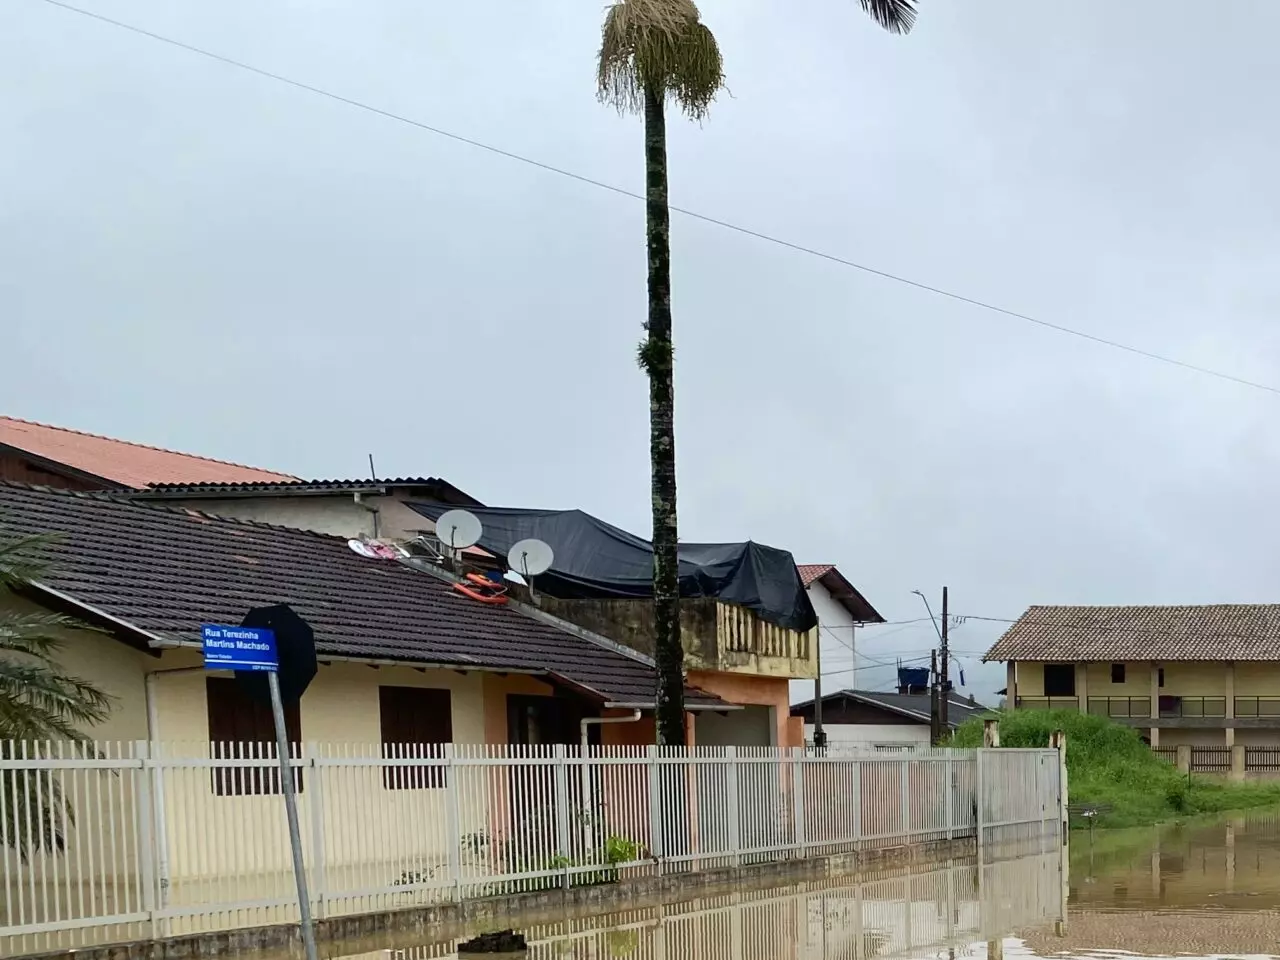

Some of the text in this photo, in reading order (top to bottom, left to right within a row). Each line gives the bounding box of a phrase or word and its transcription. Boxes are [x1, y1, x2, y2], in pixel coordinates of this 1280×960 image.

[205, 628, 259, 640] Rua Terezinha
[206, 639, 270, 650] Martins Machado
